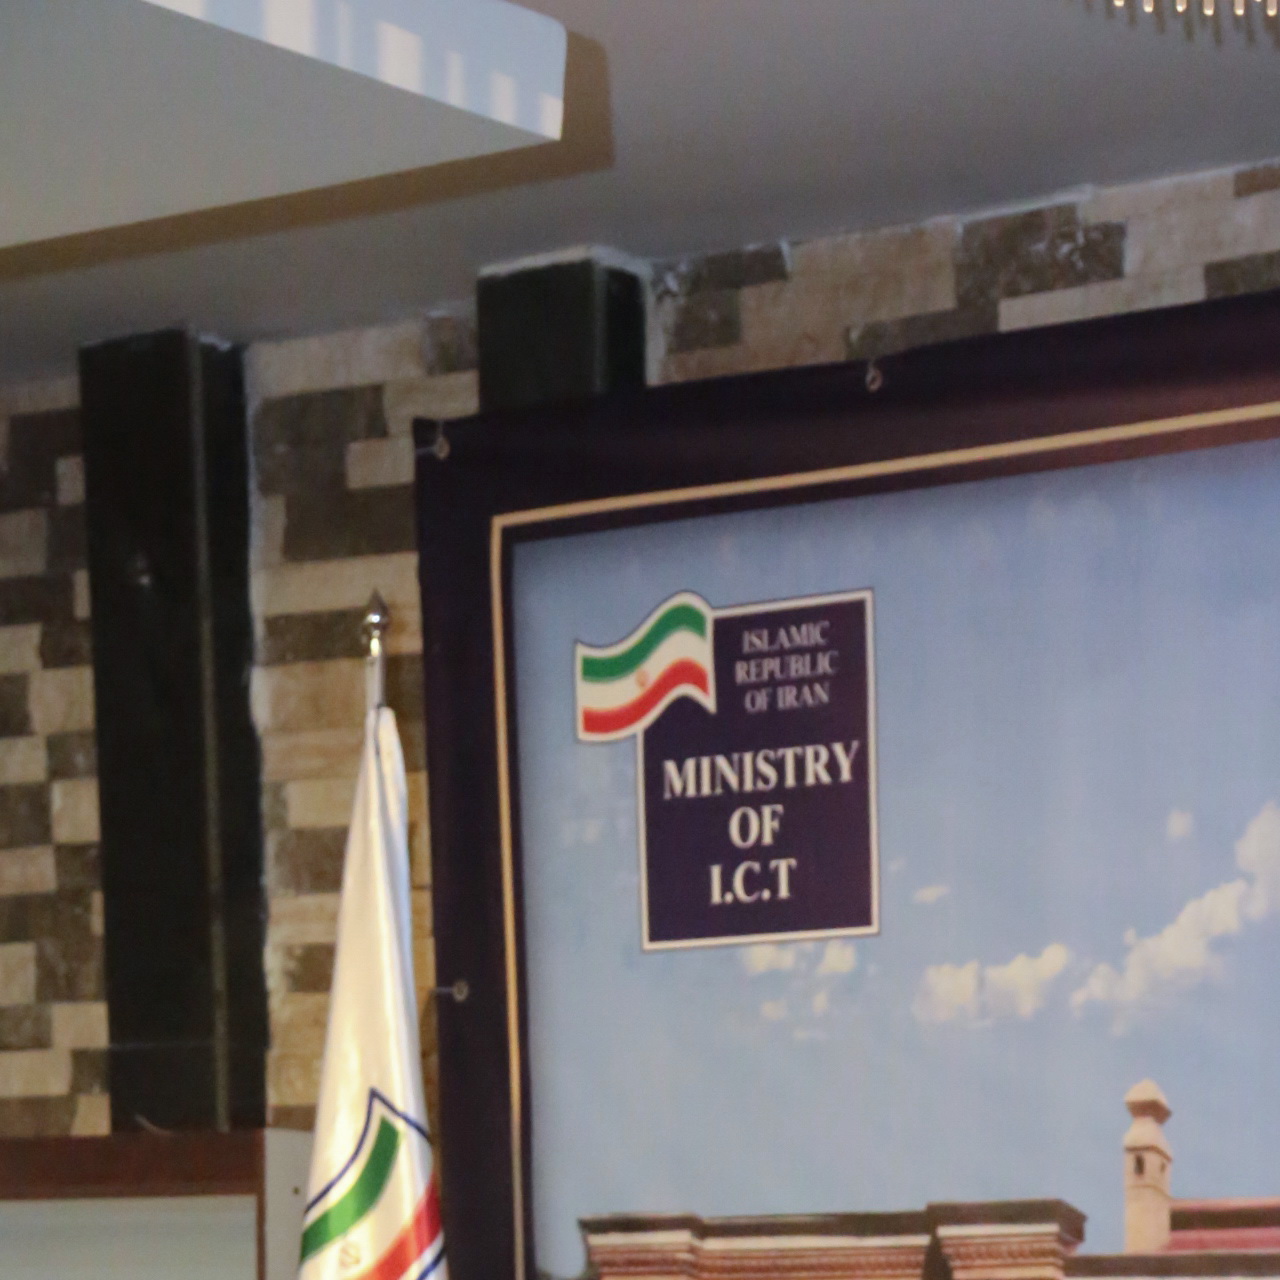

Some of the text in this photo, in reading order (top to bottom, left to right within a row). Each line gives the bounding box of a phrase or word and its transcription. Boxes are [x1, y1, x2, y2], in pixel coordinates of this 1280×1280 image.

[742, 620, 831, 654] ISLAMIC
[735, 650, 839, 684] REPUBLIC
[744, 682, 830, 713] OF IRAN
[663, 740, 860, 800] MINISTRY
[728, 804, 784, 849] OF
[709, 858, 798, 905] I.C.T
